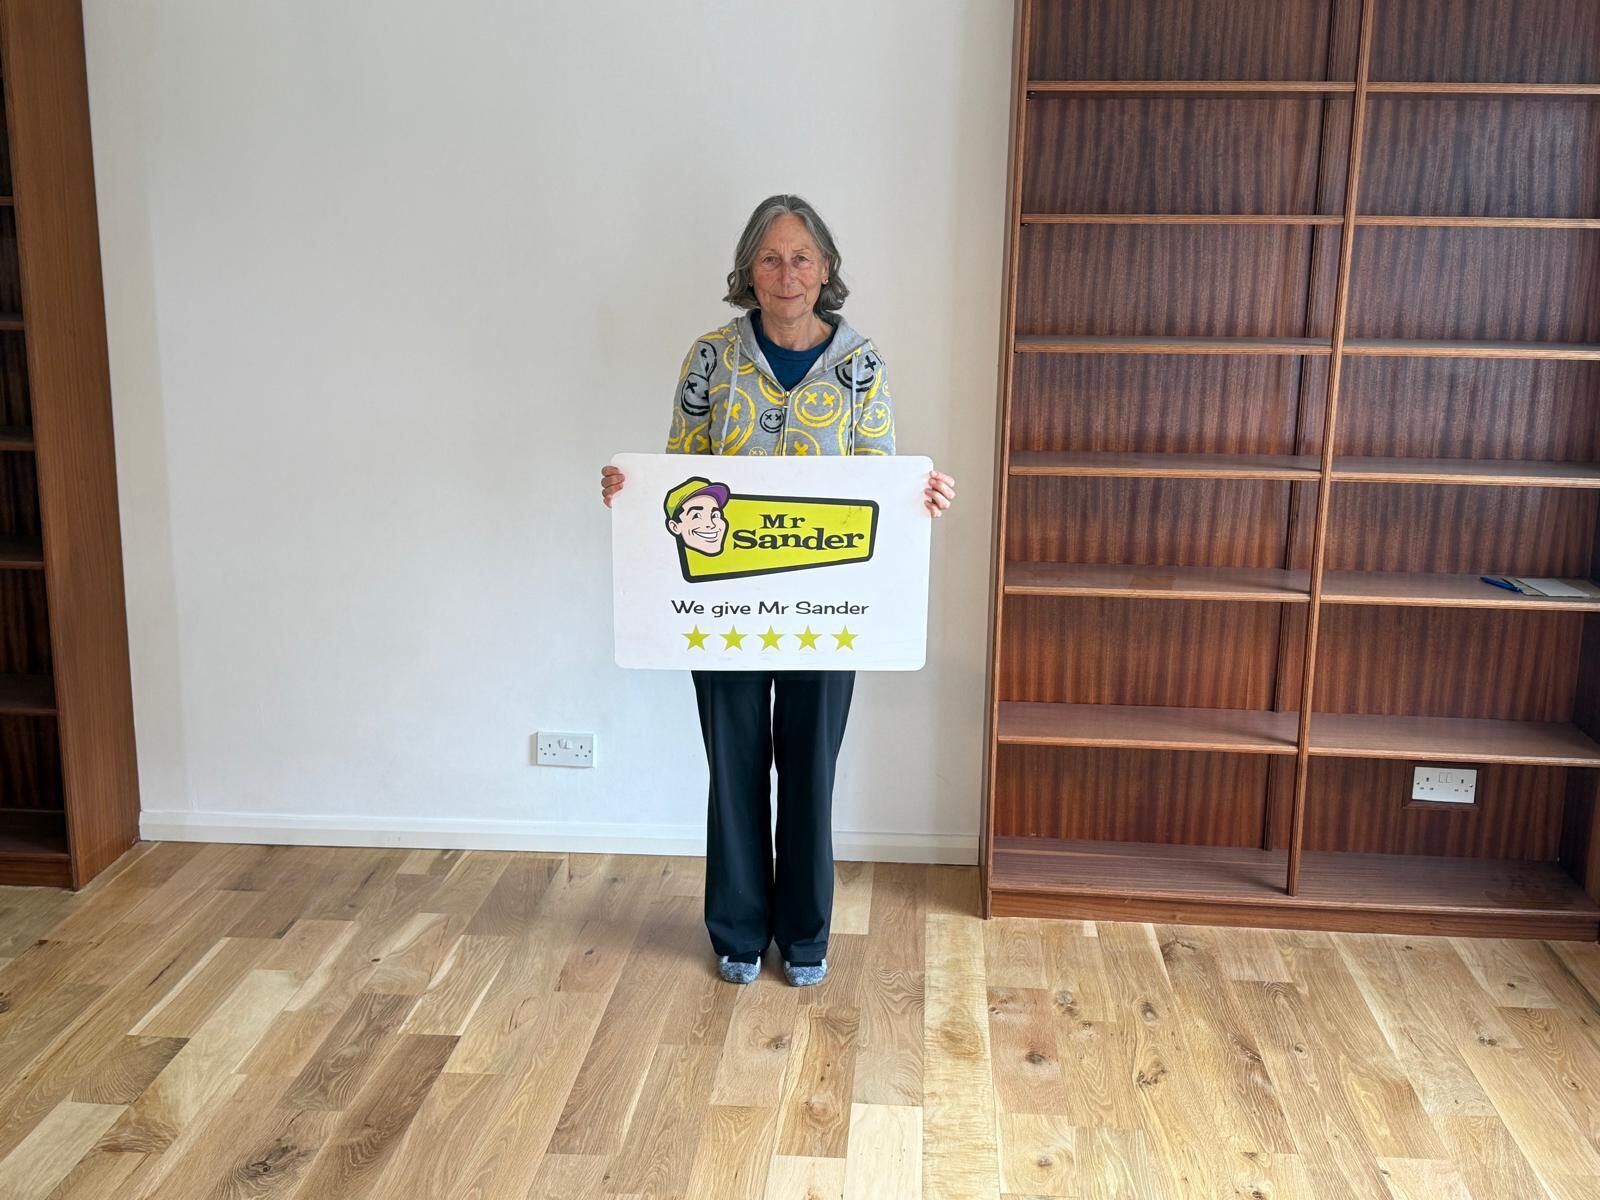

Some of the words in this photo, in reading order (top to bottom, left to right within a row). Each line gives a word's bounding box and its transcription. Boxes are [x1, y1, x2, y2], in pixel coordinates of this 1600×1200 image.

[760, 514, 806, 530] Mr
[732, 527, 865, 551] Sander
[671, 600, 705, 615] We
[711, 601, 751, 618] give
[758, 601, 789, 615] Mr
[795, 601, 870, 615] Sander
